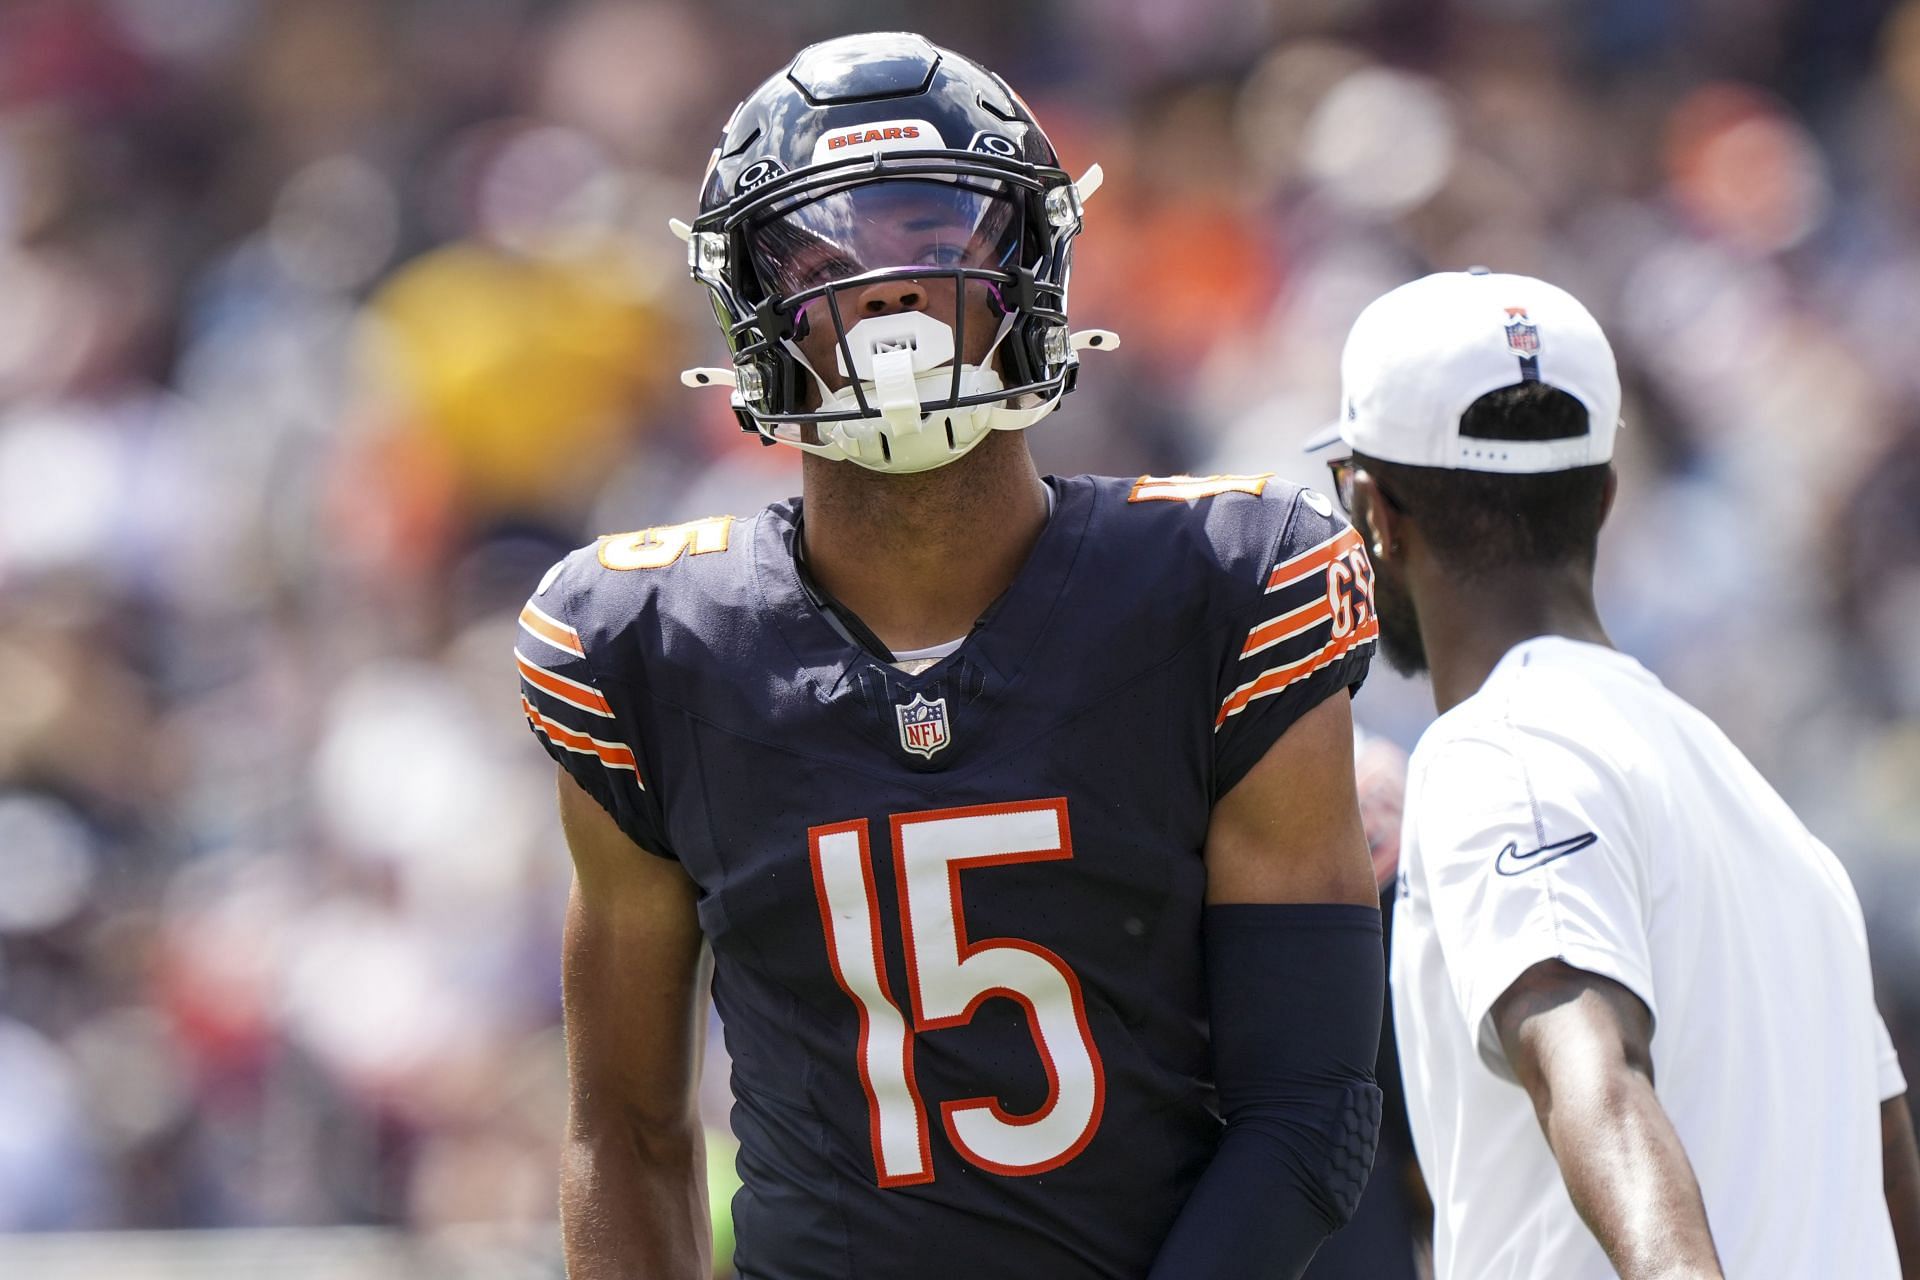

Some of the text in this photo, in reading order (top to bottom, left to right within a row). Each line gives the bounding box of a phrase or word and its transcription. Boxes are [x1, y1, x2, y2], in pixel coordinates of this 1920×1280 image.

[828, 127, 920, 150] BEARS
[907, 722, 943, 747] NFL
[807, 797, 1106, 1188] 15
